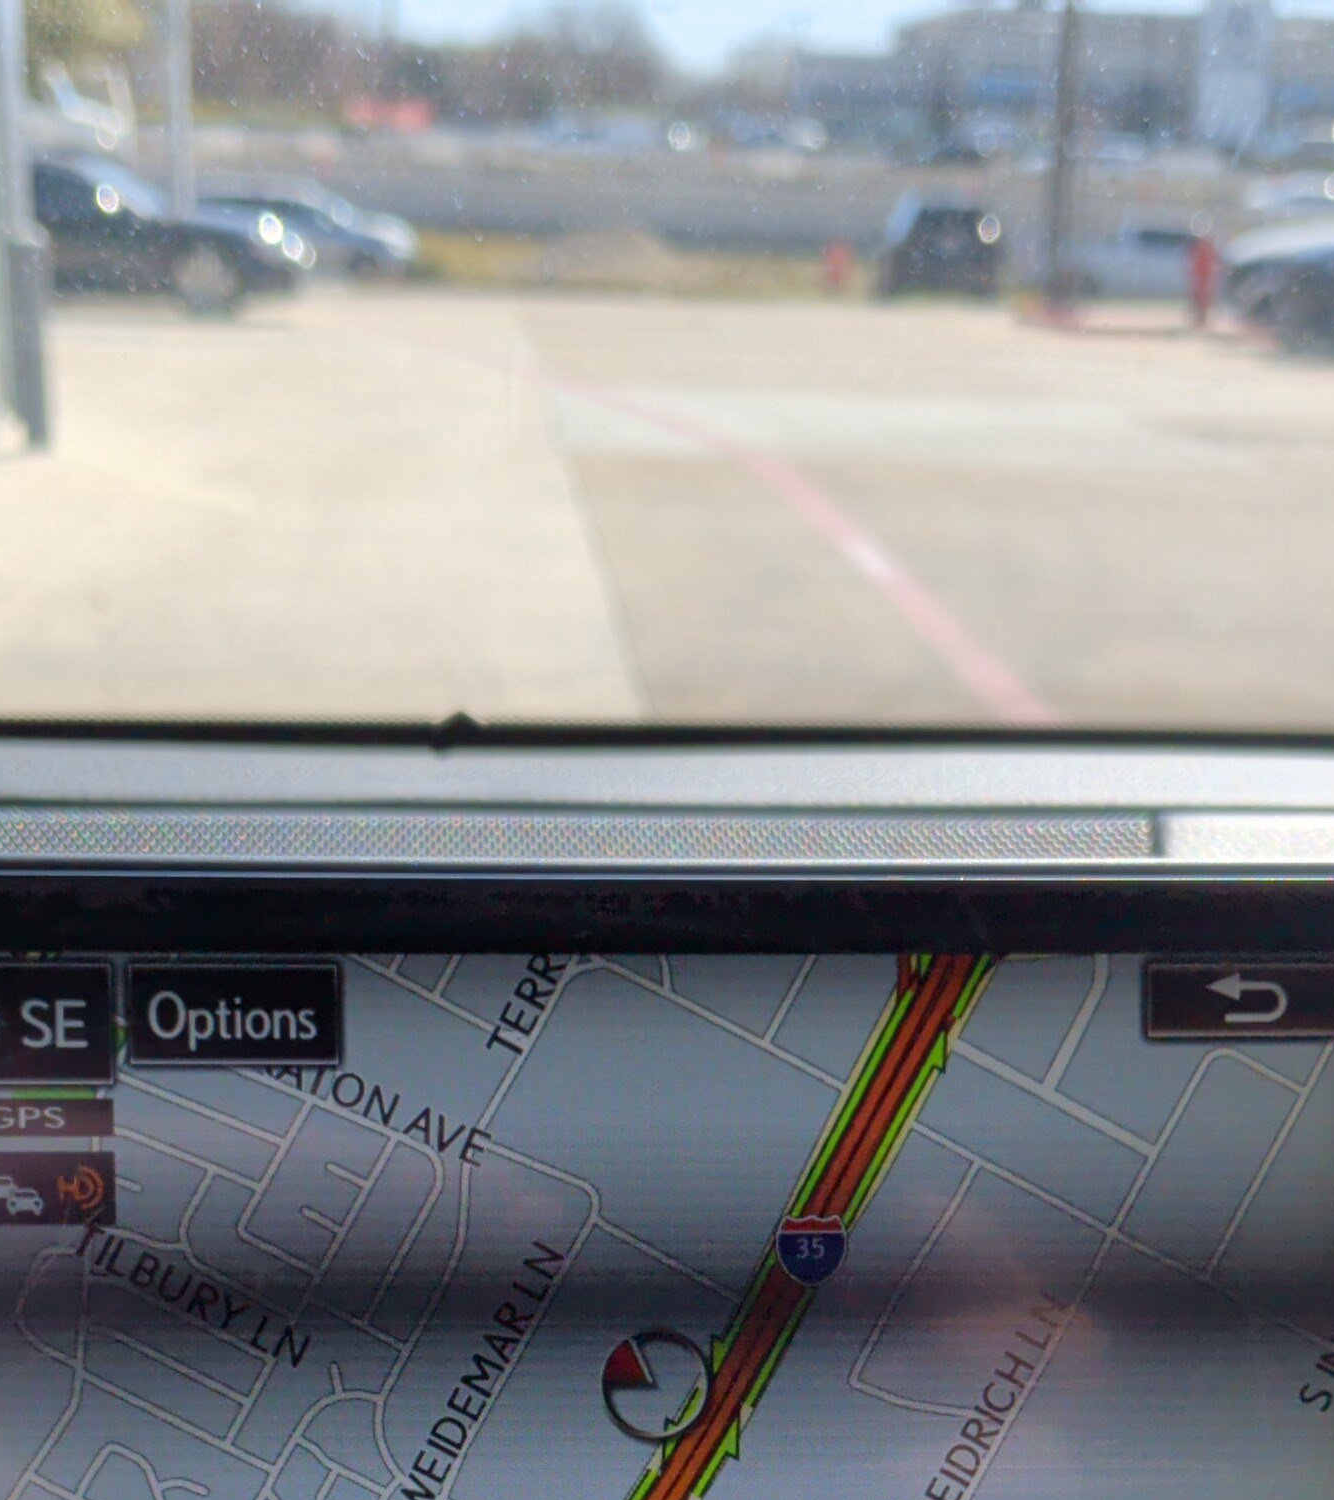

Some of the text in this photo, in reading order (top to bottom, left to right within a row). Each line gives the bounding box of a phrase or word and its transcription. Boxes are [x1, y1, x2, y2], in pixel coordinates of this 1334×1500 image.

[21, 998, 88, 1048] SE
[147, 991, 319, 1050] Options
[267, 1066, 492, 1167] ATON AVE
[512, 1240, 565, 1302] LN
[796, 1237, 825, 1259] 35
[75, 1221, 311, 1368] TILBURY LN
[1299, 1382, 1333, 1413] S
